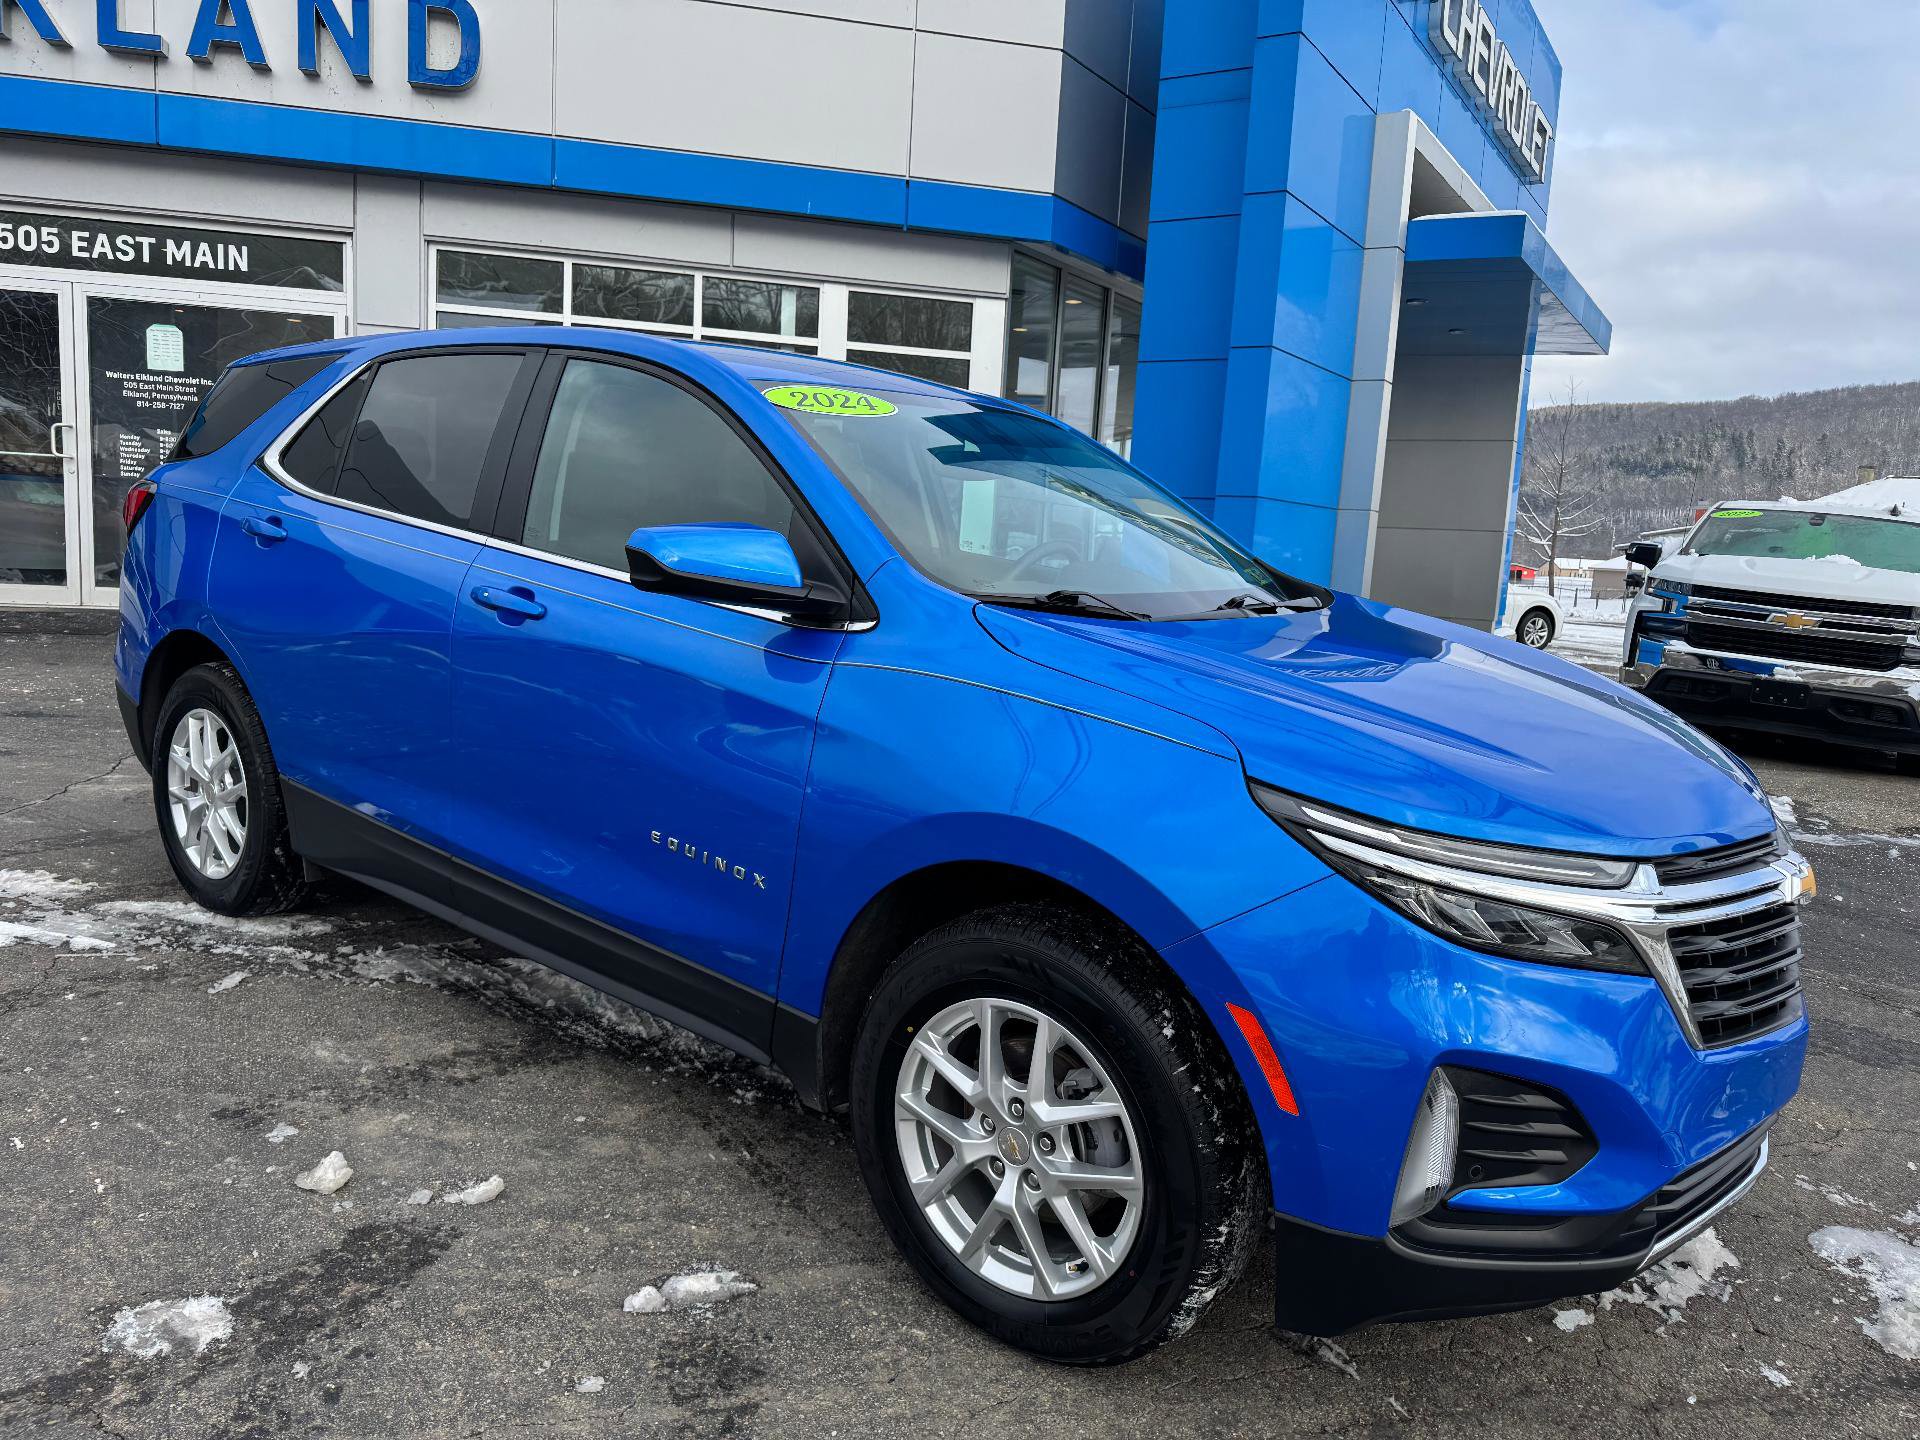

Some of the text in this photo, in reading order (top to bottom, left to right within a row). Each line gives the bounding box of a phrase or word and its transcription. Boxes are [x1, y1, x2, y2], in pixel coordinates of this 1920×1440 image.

[1438, 0, 1554, 184] CHEVROLET
[0, 223, 248, 272] 505 EAST MAIN
[106, 371, 214, 386] Walters Elkland Chevrolet Inc.
[139, 383, 155, 391] East
[156, 384, 174, 392] Main
[174, 385, 197, 393] Street
[123, 390, 198, 402] Elkland, Pennsylvania
[790, 391, 878, 411] 2024
[119, 446, 151, 454] Wednesday
[120, 471, 141, 479] Sunday
[650, 830, 766, 890] EQUINOX
